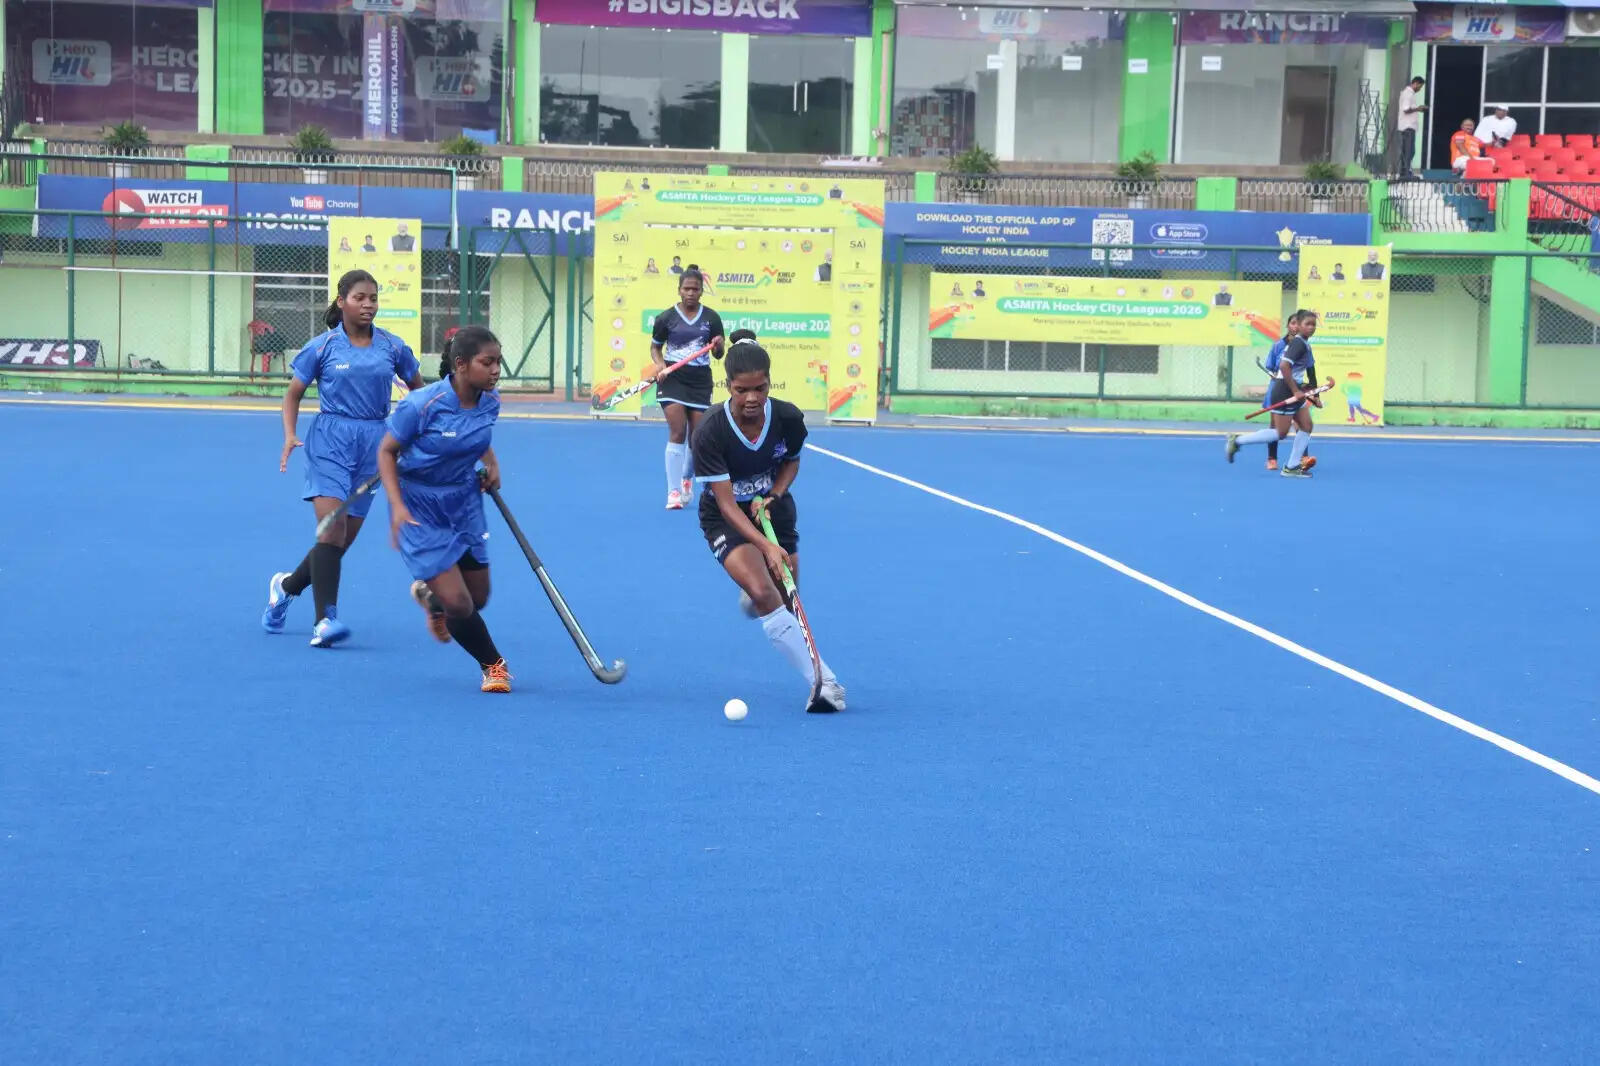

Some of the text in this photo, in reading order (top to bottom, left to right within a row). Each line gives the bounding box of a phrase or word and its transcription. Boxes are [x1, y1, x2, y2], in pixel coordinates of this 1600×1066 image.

[608, 0, 800, 19] #BIGISBACK
[156, 72, 198, 93] LE
[368, 32, 382, 125] #HEROHIL
[390, 26, 399, 134] #HOCKEYKAJASHN
[147, 192, 197, 204] WATCH
[326, 199, 359, 209] Channe
[661, 191, 698, 200] ASMITA
[700, 192, 736, 203] Hockey
[737, 193, 757, 204] City
[758, 194, 793, 206] League
[149, 208, 223, 225] LIVE ON
[491, 208, 595, 235] RANCH
[916, 213, 1076, 226] DOWNLOAD THE OFFICIAL APP OF
[962, 226, 1030, 235] HOCKEY INDIA
[1169, 229, 1201, 238] App Store
[612, 233, 629, 242] SAI
[675, 238, 690, 247] SAI
[849, 239, 866, 248] SAI
[941, 246, 1049, 257] HOCKEY INDIA LEAGUE
[717, 273, 755, 283] ASMITA
[1004, 299, 1203, 316] ASMITA Hockey City League 2026
[1325, 311, 1351, 319] ASMITA
[739, 319, 763, 332] City
[765, 319, 808, 332] League
[810, 319, 830, 331] 202
